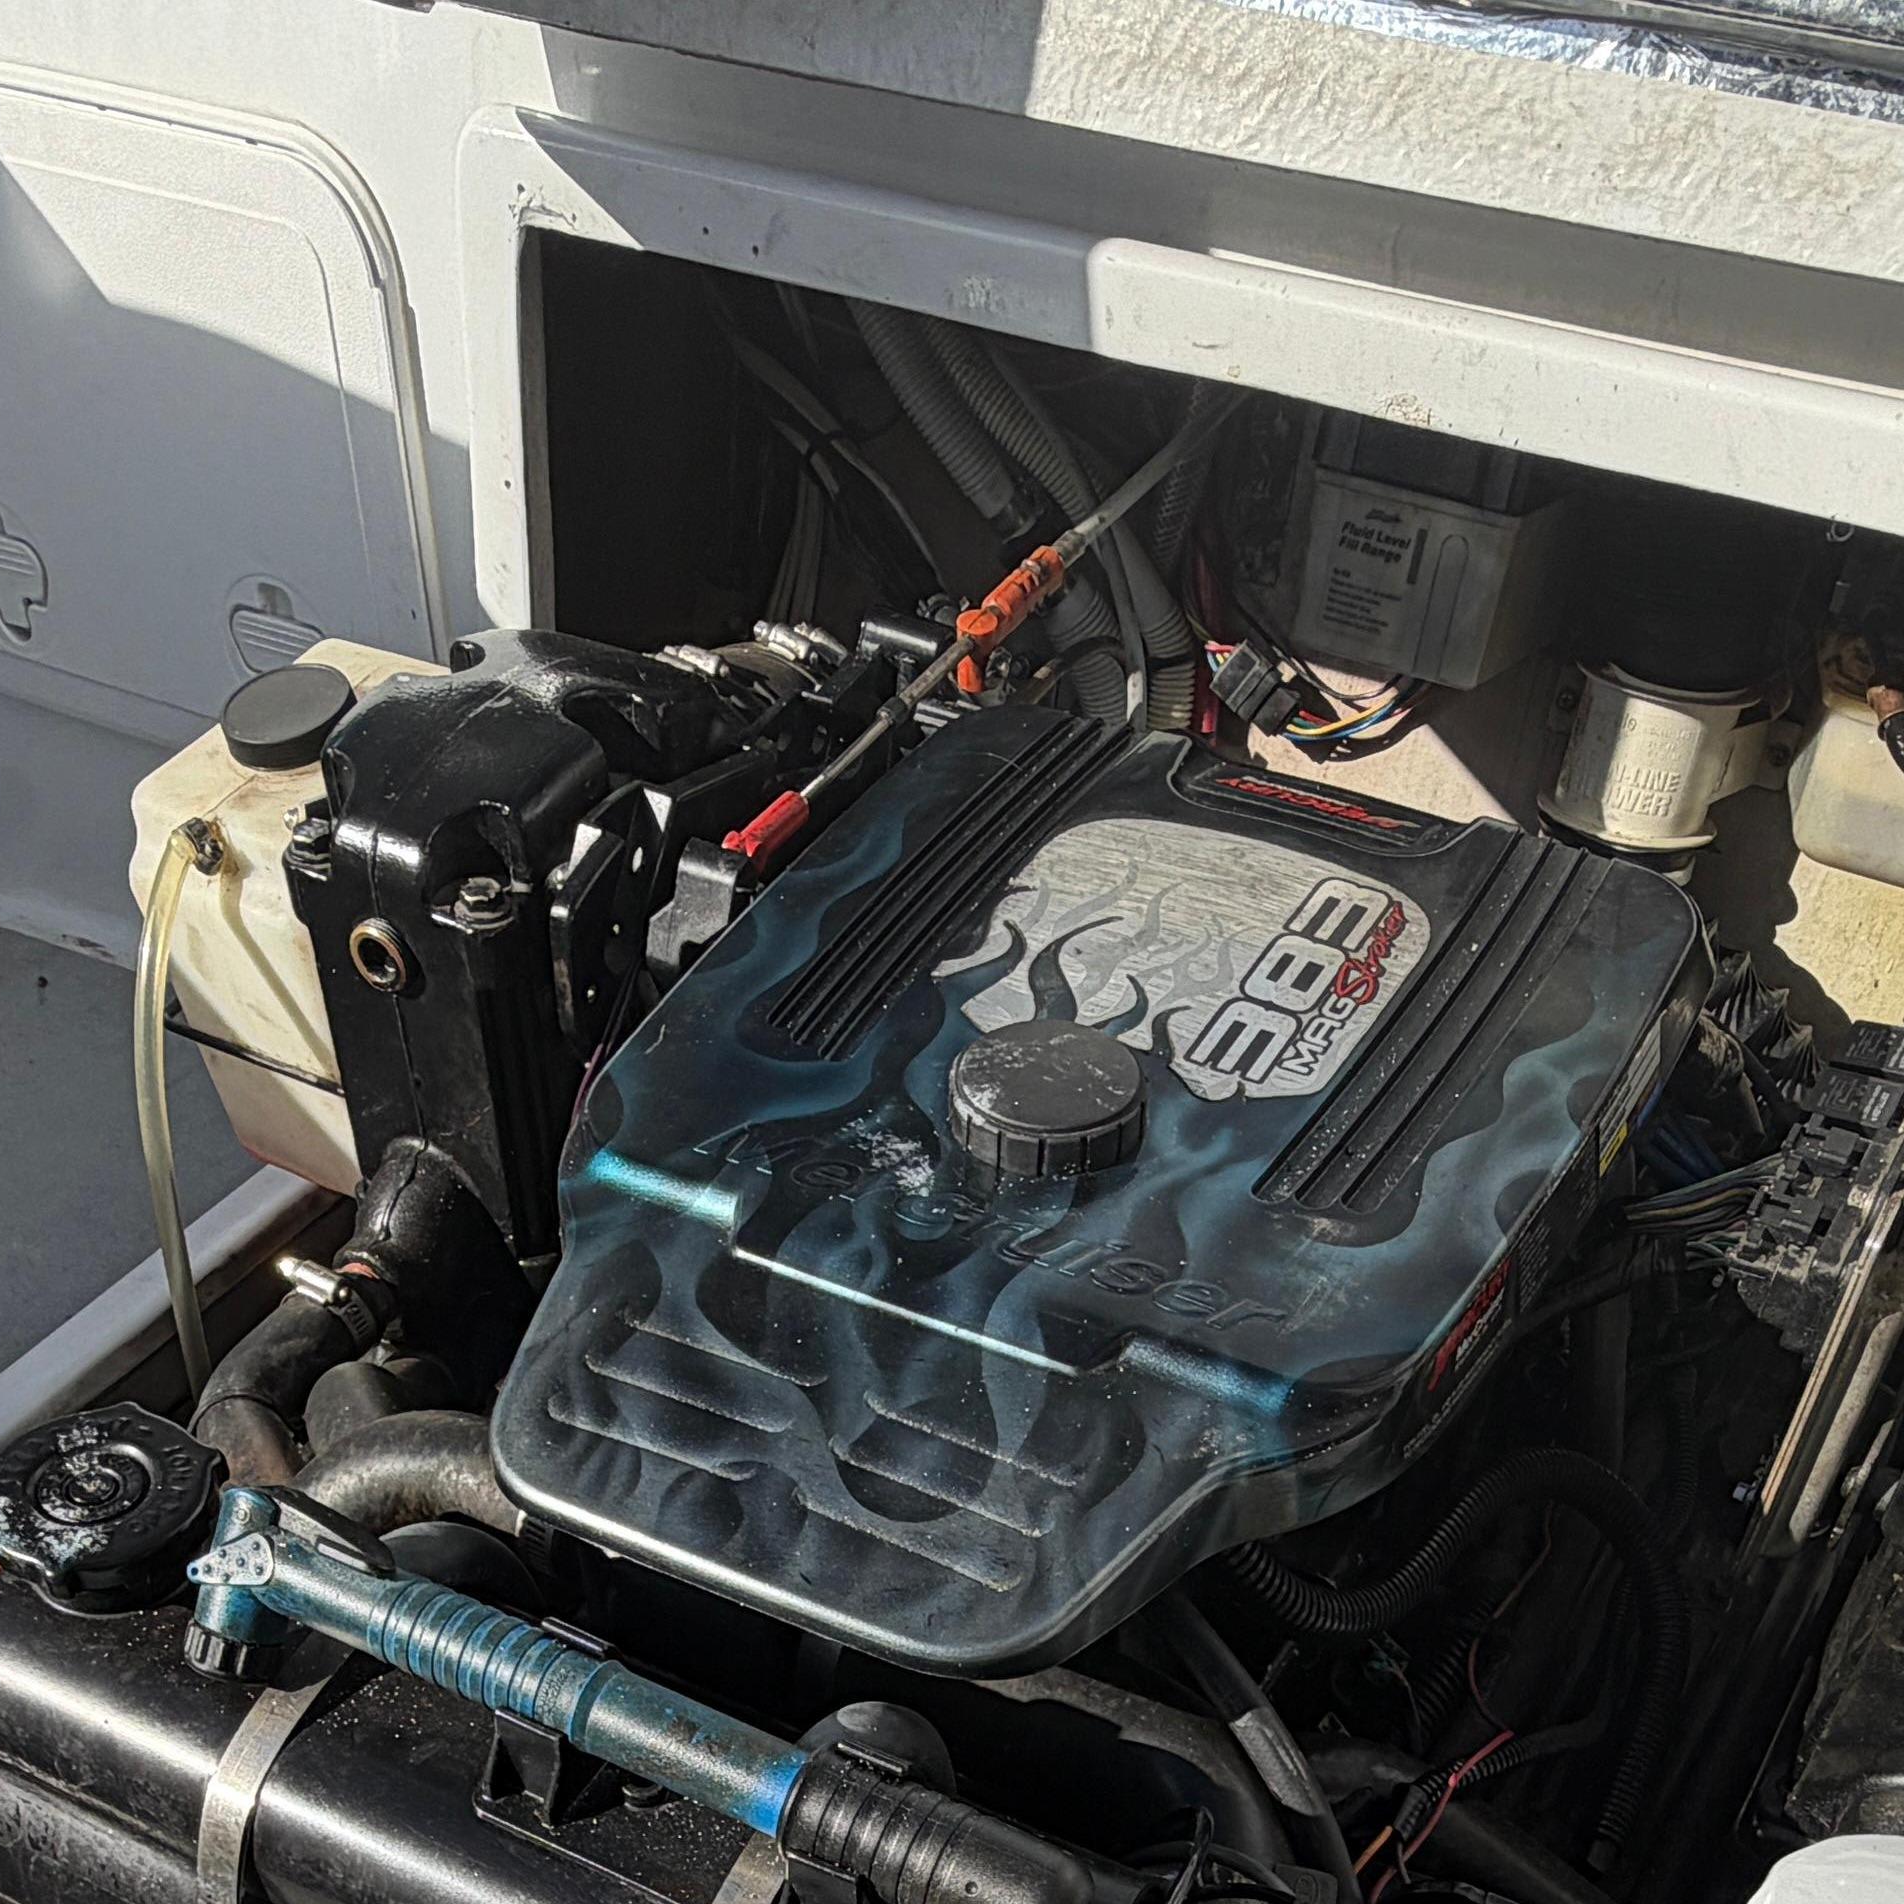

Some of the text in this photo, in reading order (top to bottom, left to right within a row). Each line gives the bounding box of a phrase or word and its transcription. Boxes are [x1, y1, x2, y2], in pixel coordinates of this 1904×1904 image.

[1338, 535, 1401, 563] Fill Range
[1341, 521, 1411, 550] Fluid Level
[1183, 877, 1393, 1083] 383
[1277, 900, 1408, 1076] MAG Stroker
